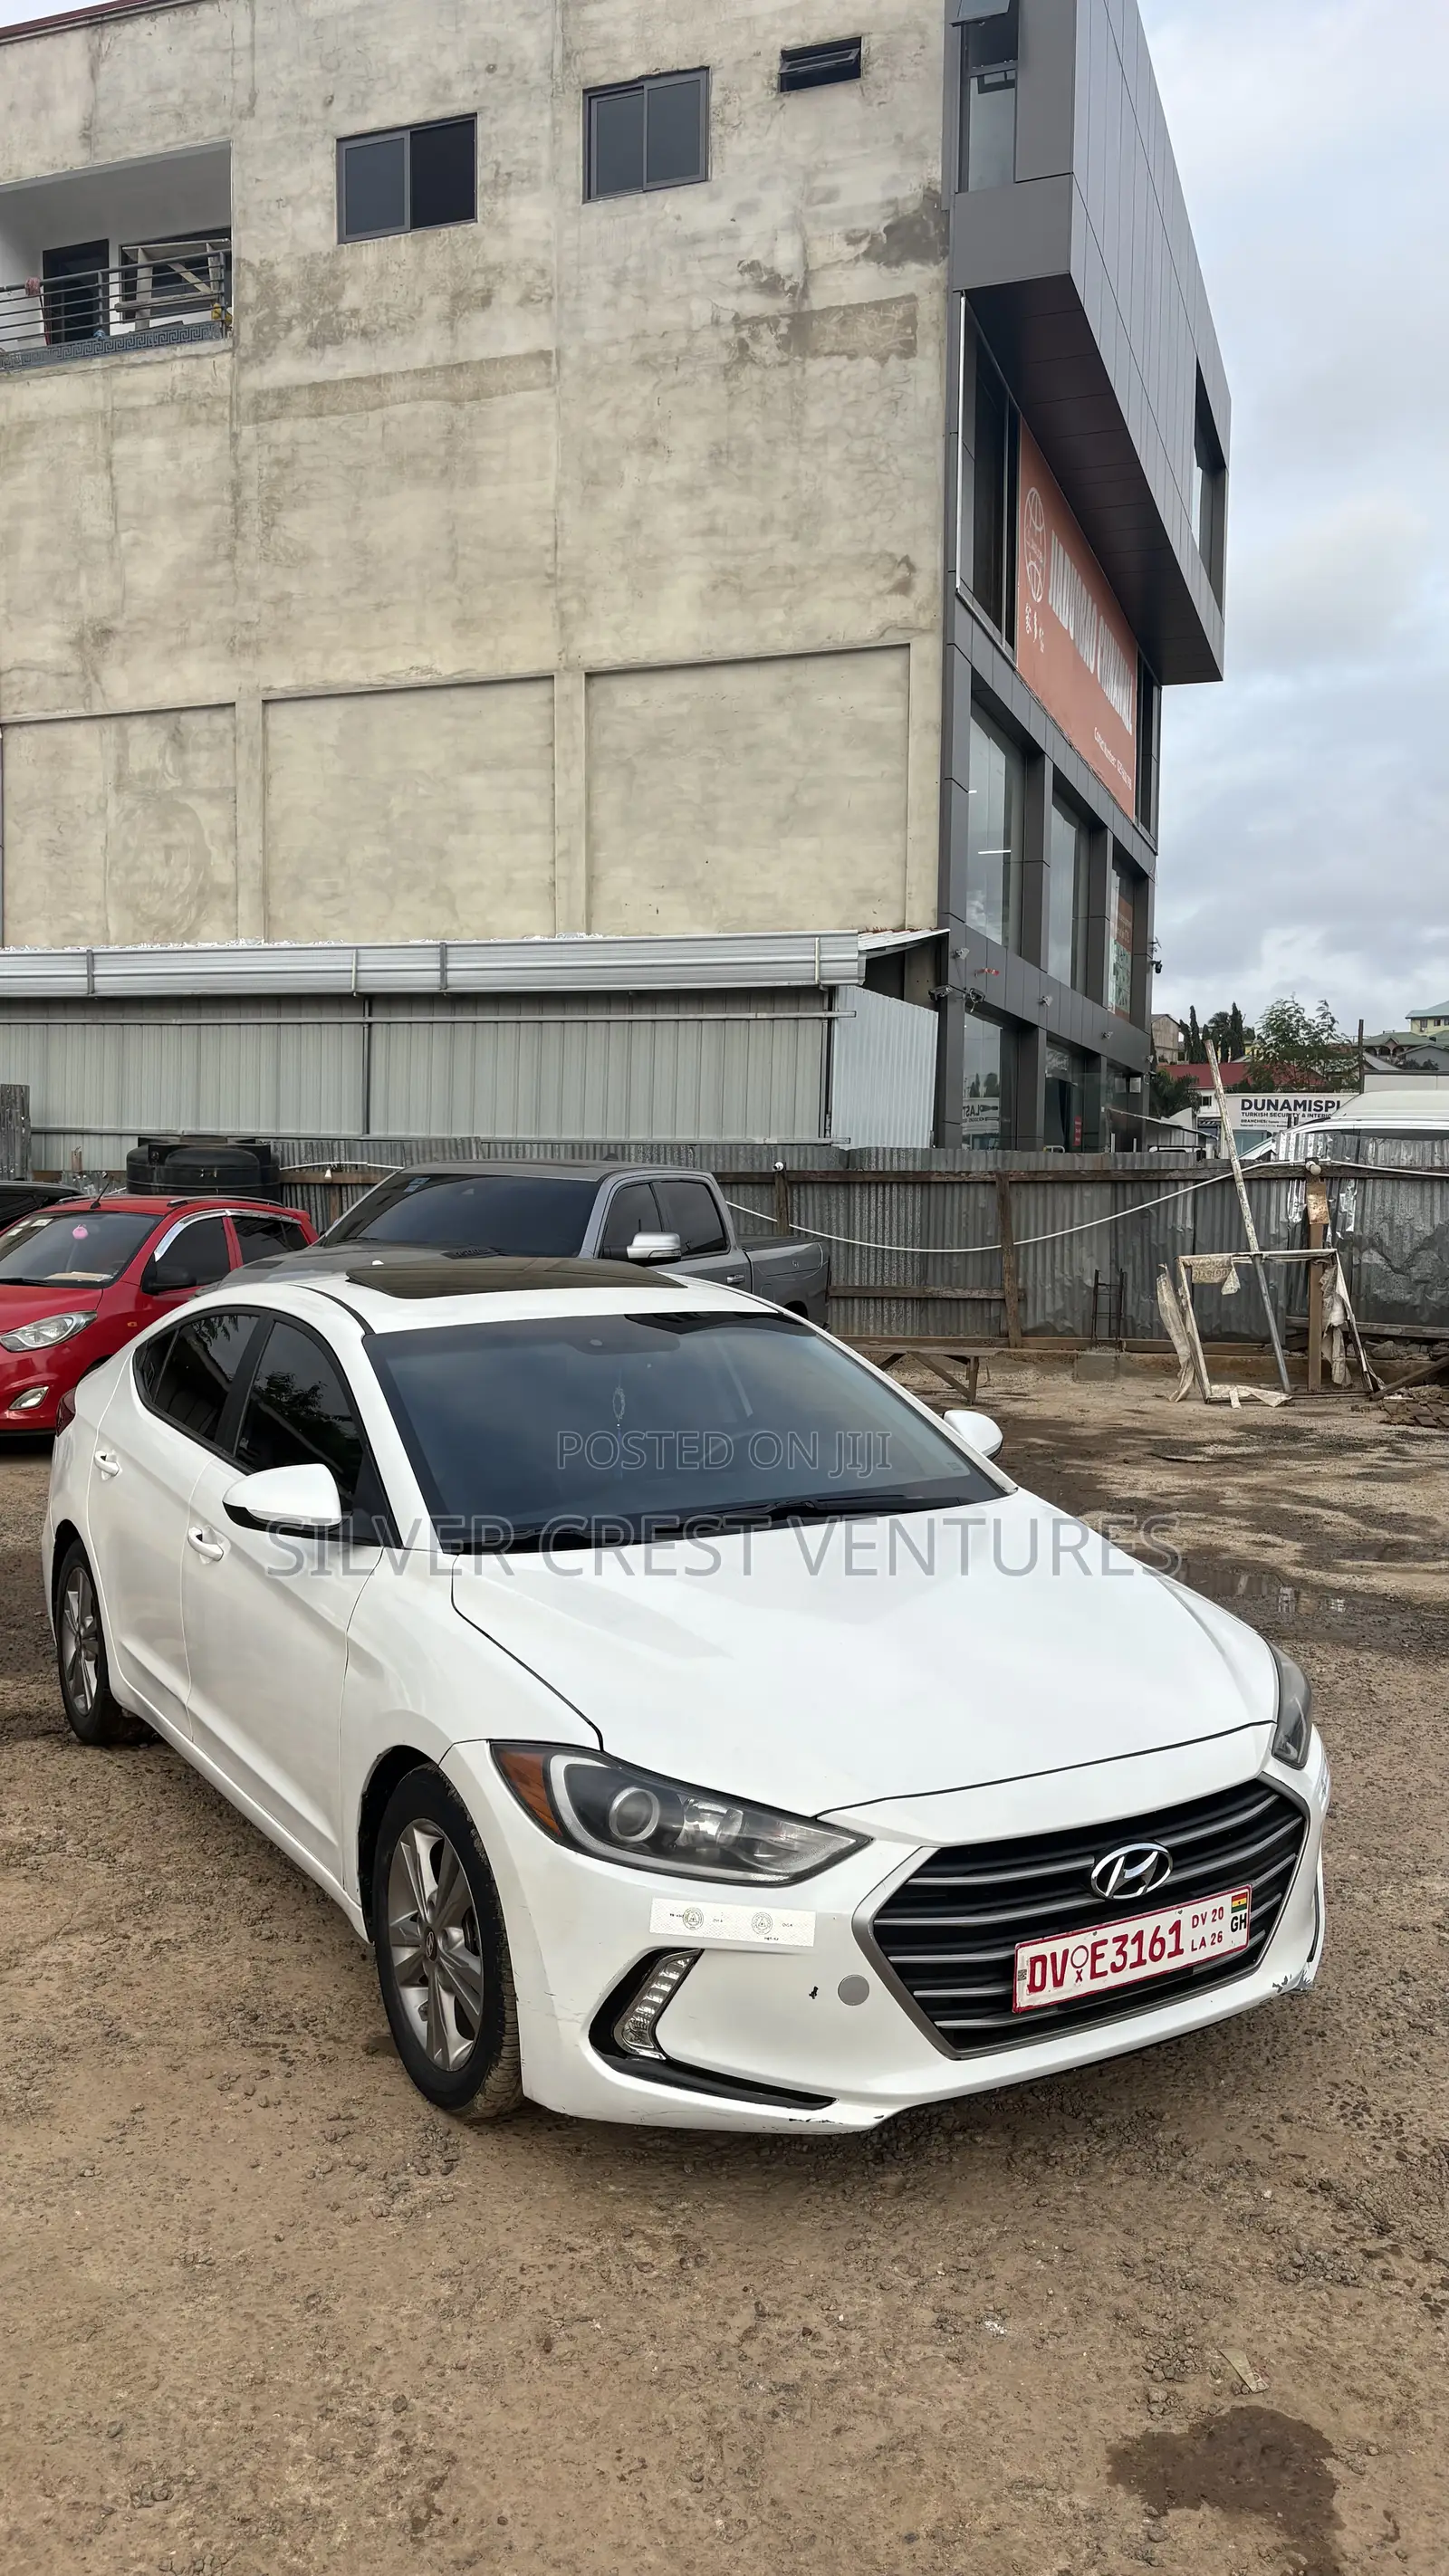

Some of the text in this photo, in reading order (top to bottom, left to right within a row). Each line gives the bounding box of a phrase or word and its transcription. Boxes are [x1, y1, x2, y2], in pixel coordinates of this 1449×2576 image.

[1191, 1906, 1224, 1929] DV 20
[1230, 1913, 1248, 1932] GH
[1089, 1919, 1185, 1980] E3161
[1191, 1936, 1207, 1952] LA
